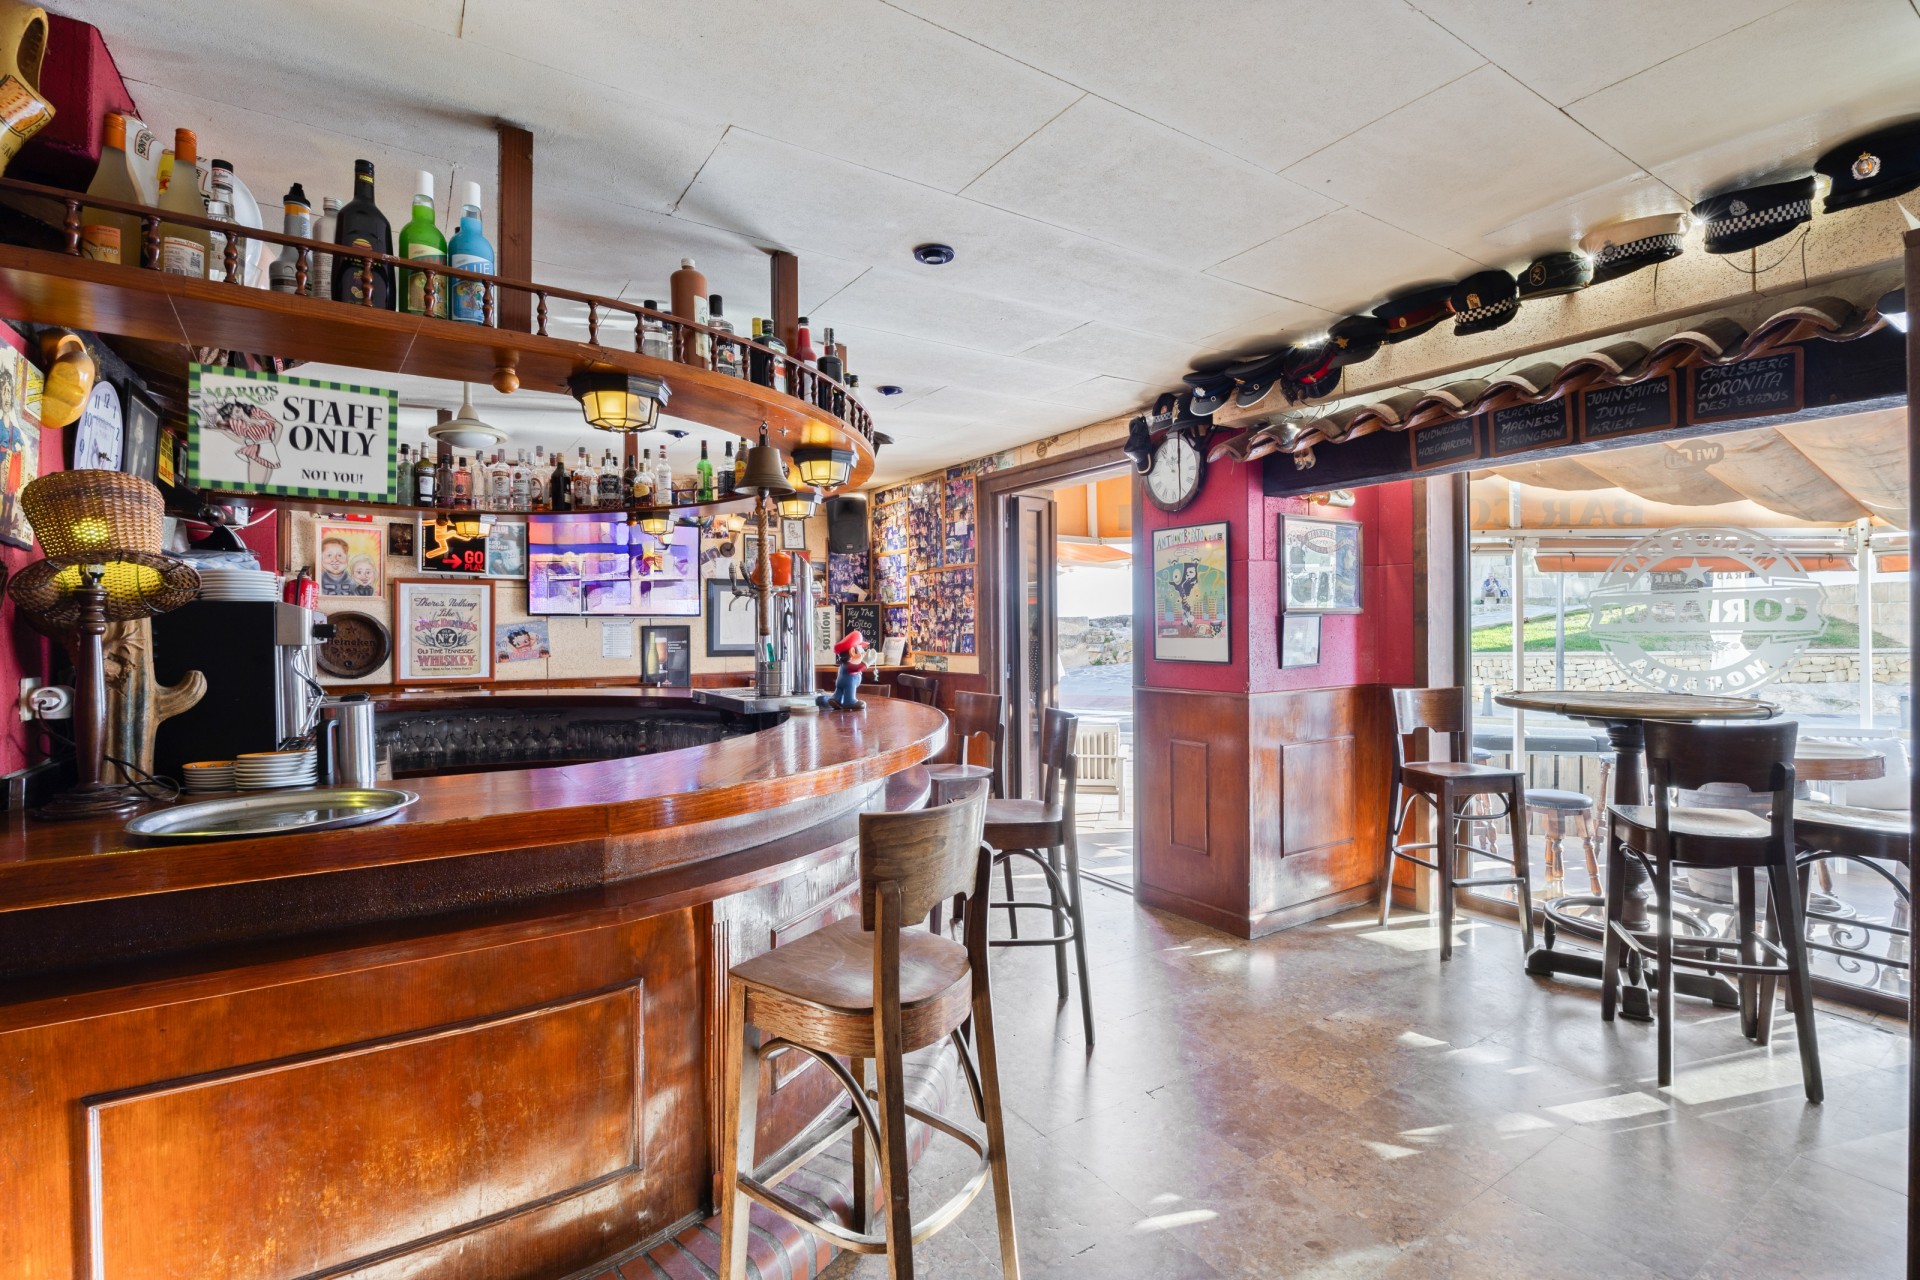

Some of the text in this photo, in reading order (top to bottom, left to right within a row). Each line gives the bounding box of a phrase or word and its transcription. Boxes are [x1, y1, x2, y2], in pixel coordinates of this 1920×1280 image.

[1700, 357, 1789, 381] CARLSBERG
[1587, 381, 1668, 407] JOHN SMITHS
[1697, 372, 1783, 399] CORONITA
[283, 396, 383, 431] STAFF
[1501, 412, 1560, 434] MAGNERS
[289, 425, 378, 458] ONLY
[1417, 420, 1470, 444] BUDWEISER
[1498, 424, 1565, 449] STRONGBOW
[1418, 436, 1473, 457] HOEGAARDEN
[301, 468, 364, 484] NOT YOU!
[464, 550, 484, 564] GO
[464, 564, 484, 572] PLAY
[414, 597, 478, 611] There's Nothing
[437, 608, 455, 617] Like
[846, 607, 875, 619] Try The
[822, 611, 831, 651] MOJITOS
[416, 654, 477, 667] WHISKEY
